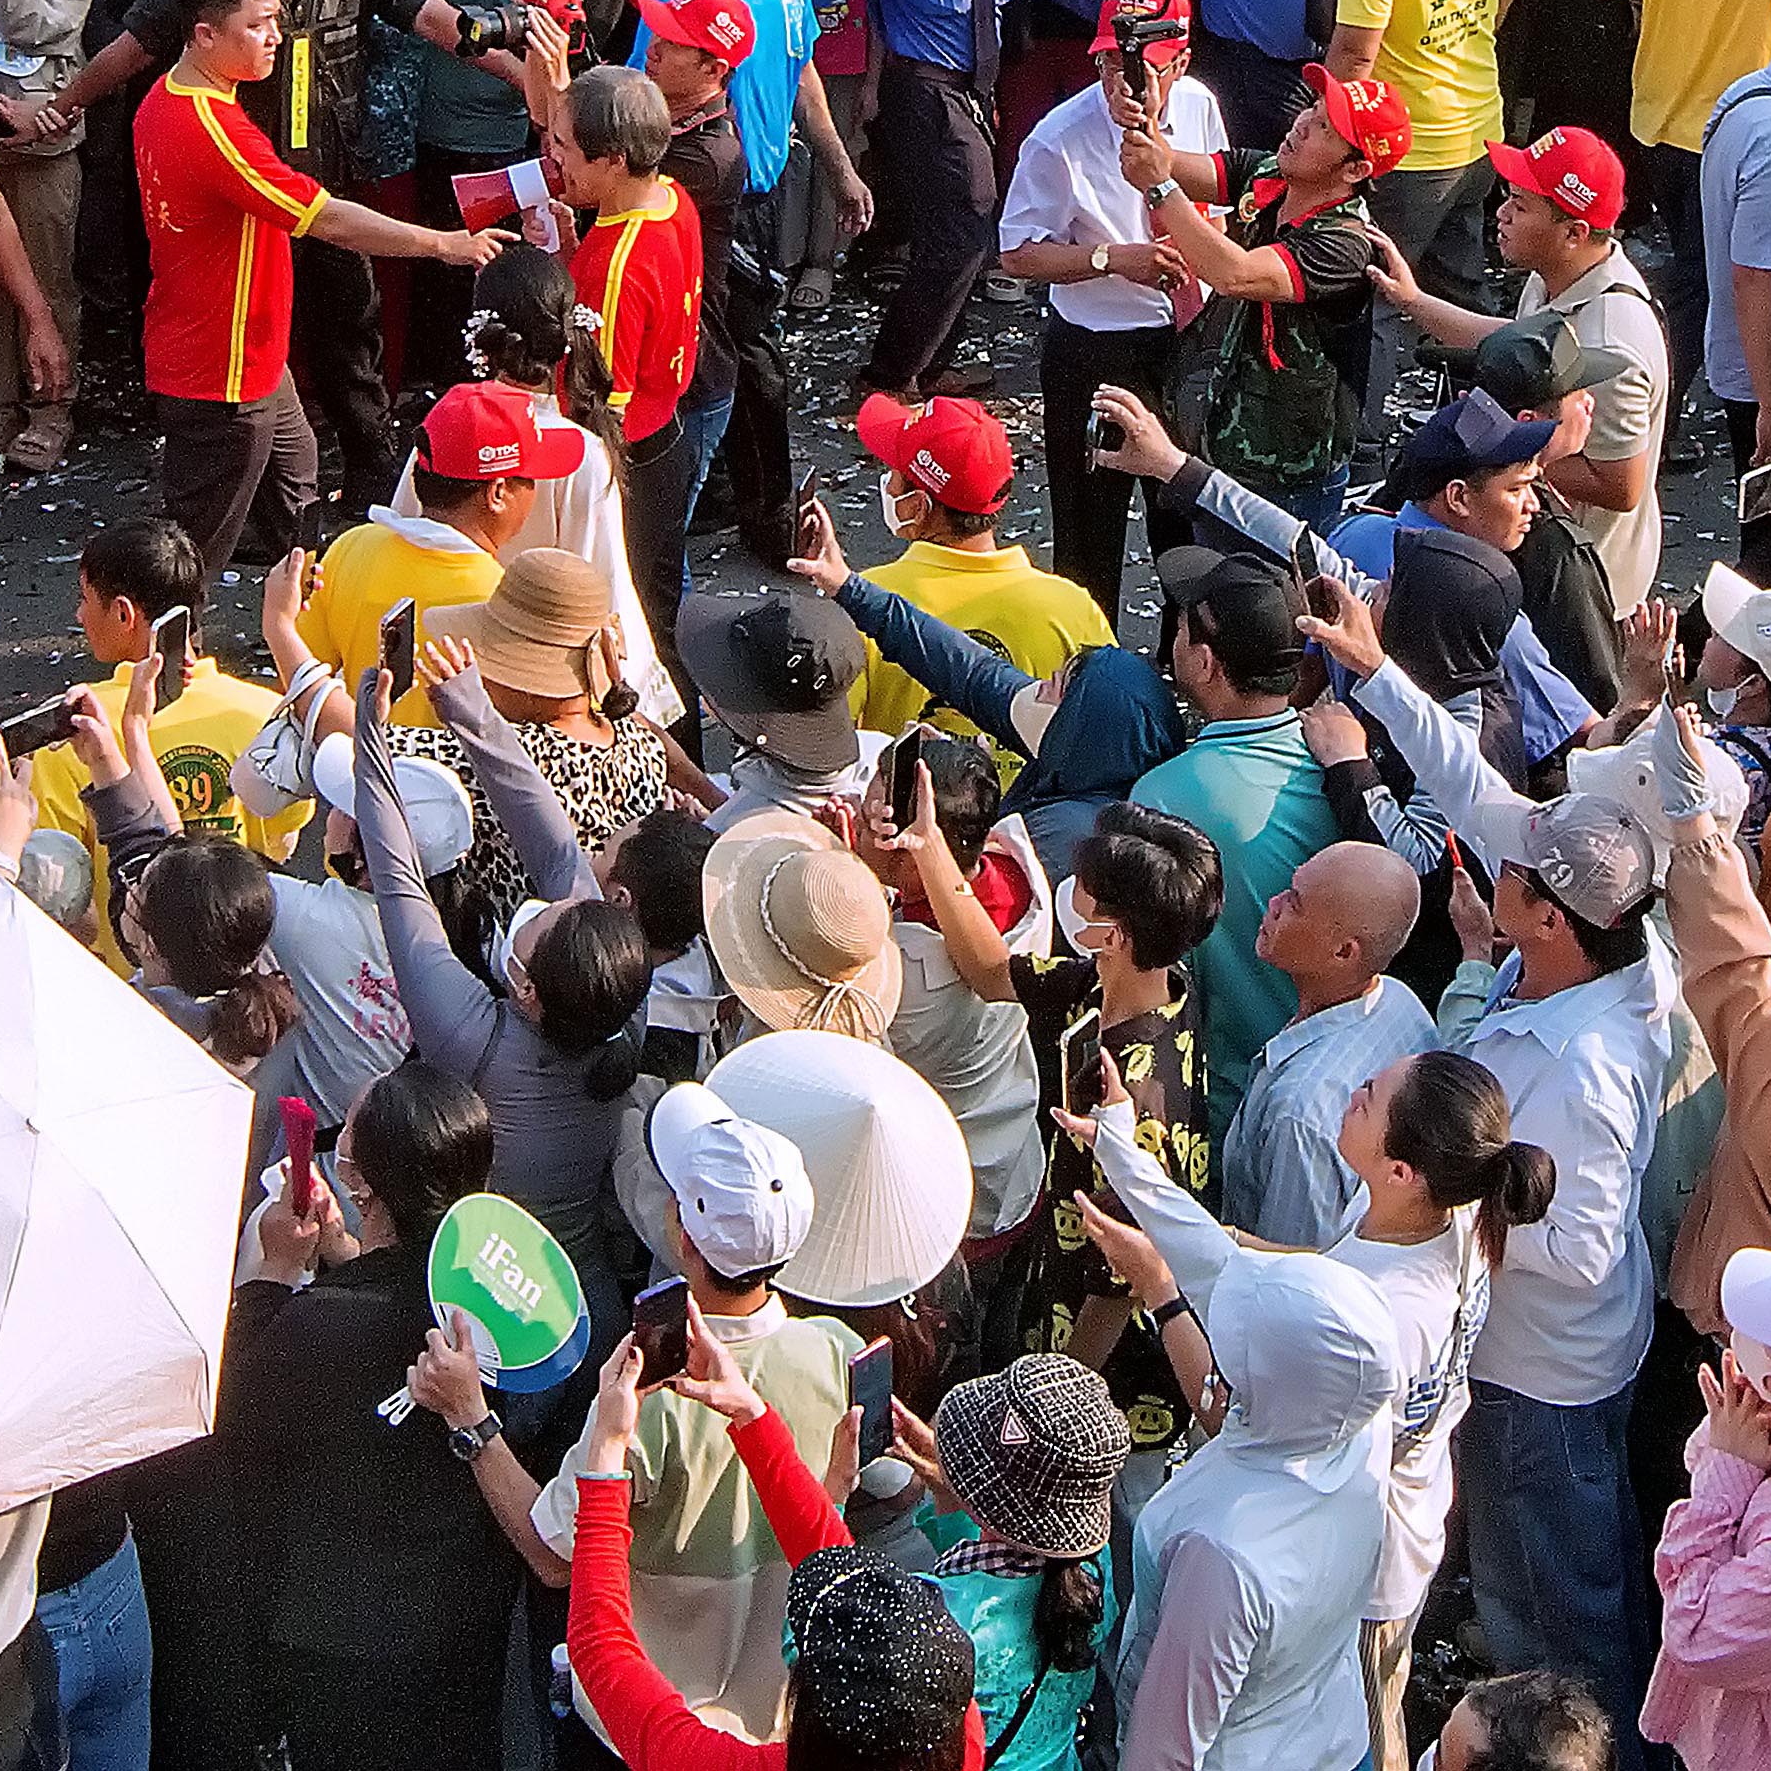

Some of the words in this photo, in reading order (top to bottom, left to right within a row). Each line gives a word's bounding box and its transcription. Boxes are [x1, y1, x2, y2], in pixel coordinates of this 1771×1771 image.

[1576, 185, 1598, 201] TDC
[495, 442, 520, 457] TDC
[929, 460, 953, 481] TDC
[169, 771, 212, 814] 89
[479, 1232, 542, 1309] iFan
